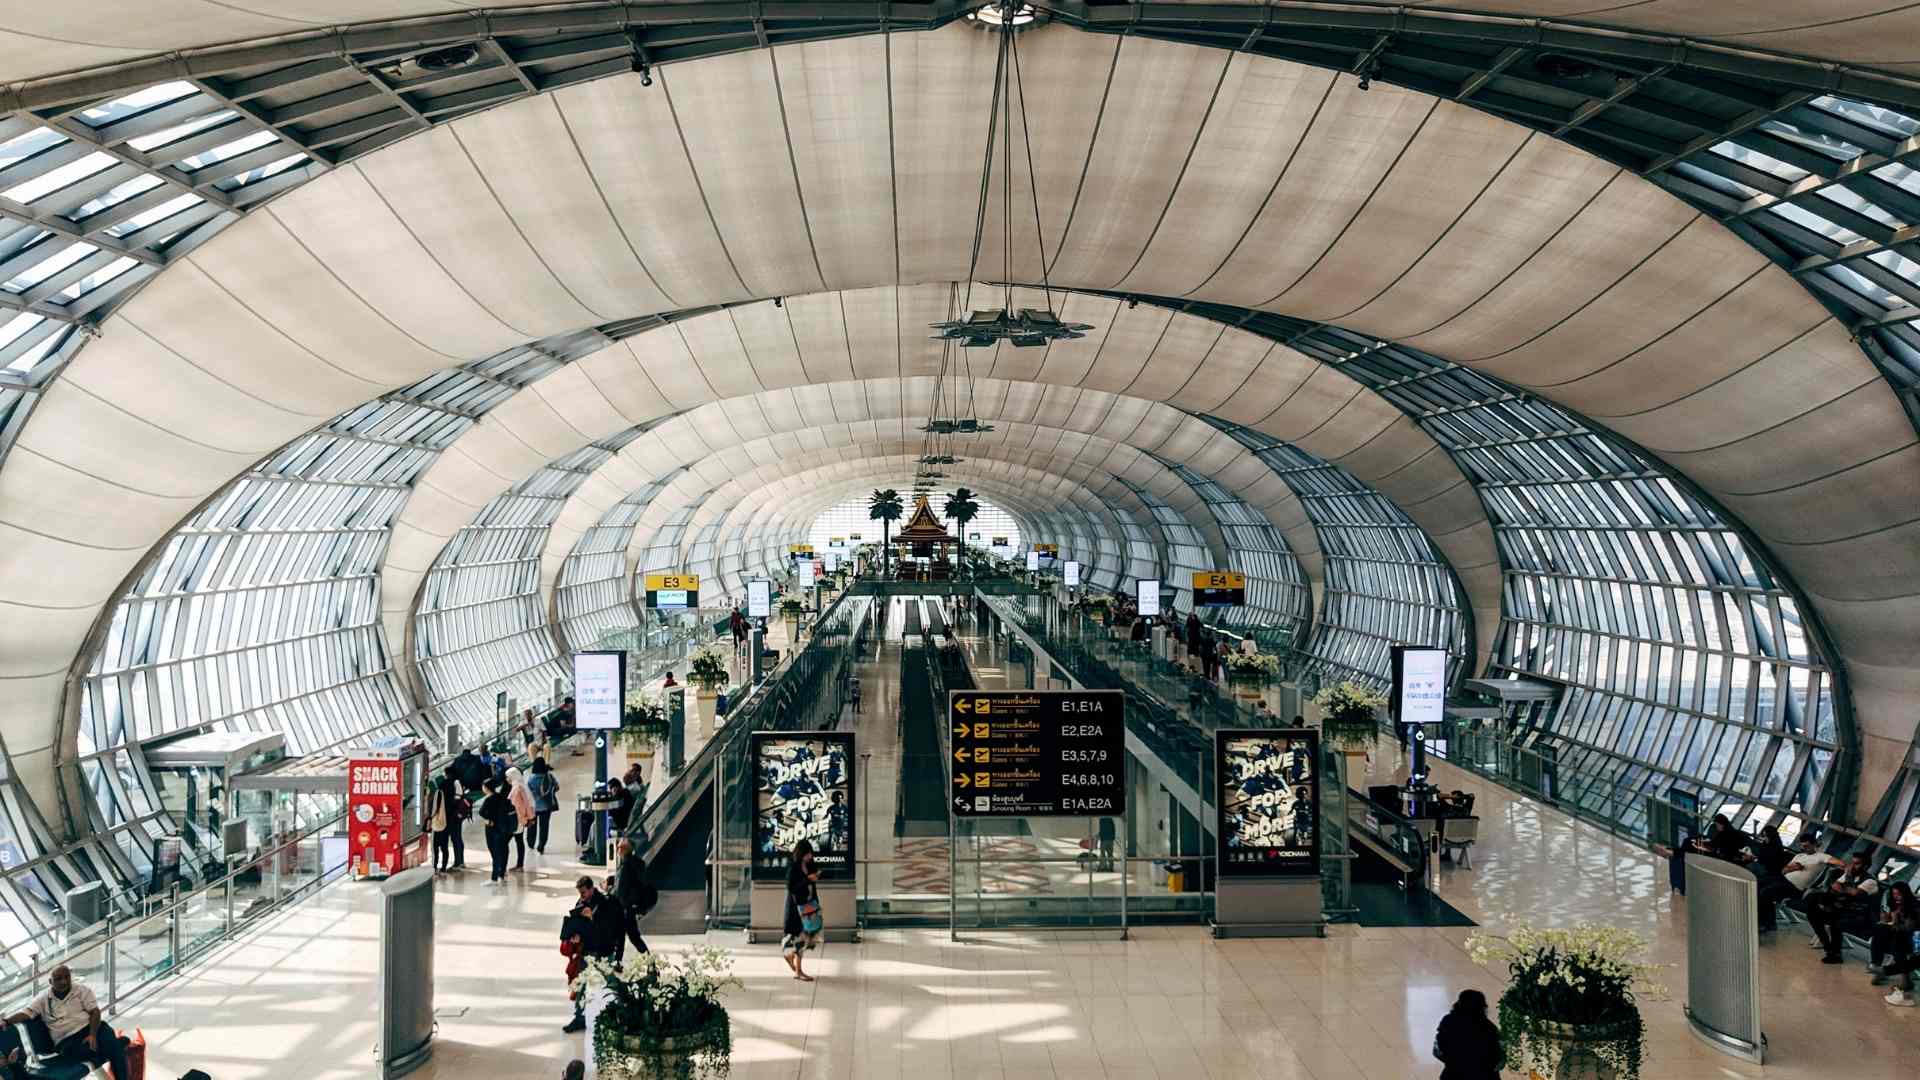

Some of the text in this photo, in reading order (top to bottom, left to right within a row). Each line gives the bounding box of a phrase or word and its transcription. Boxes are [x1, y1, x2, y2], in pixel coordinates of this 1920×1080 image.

[663, 577, 680, 588] E3
[1210, 575, 1226, 586] E4
[1061, 701, 1103, 713] E1,E1A
[1061, 725, 1103, 737] E2,E2A
[1061, 750, 1107, 762] E3,5,7,9
[773, 755, 830, 785] DRIVE
[1241, 751, 1294, 780] DRIVE
[353, 766, 398, 781] SNACK
[1061, 774, 1114, 786] E4,6,8,10
[352, 782, 399, 795] &DRINK
[785, 793, 824, 816] FOR
[1062, 798, 1112, 810] E1A,E2A
[1251, 788, 1289, 811] FOR
[778, 819, 830, 845] MORE
[1245, 814, 1295, 839] MORE
